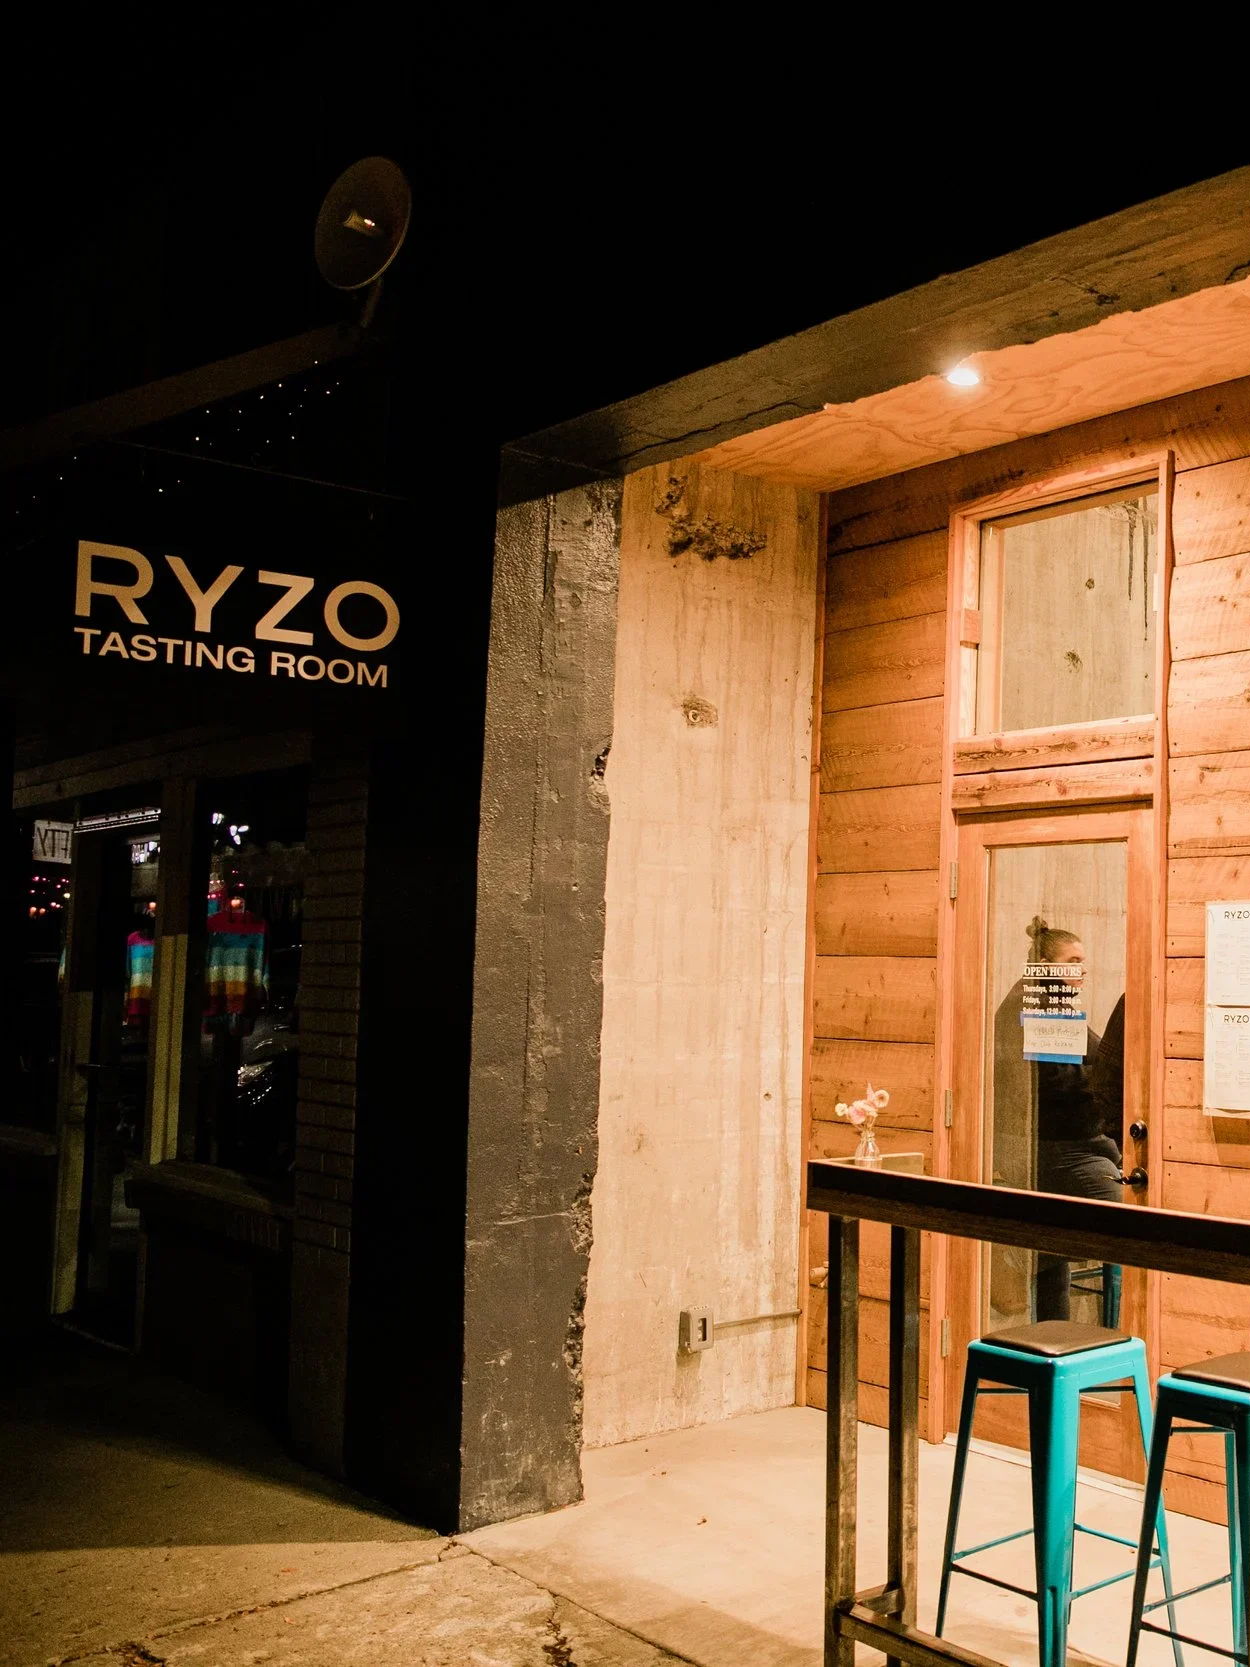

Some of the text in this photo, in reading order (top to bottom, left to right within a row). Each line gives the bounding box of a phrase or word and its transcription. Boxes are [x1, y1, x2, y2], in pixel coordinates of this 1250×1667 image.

[74, 540, 400, 651] RYZO
[74, 627, 388, 688] TASTING ROOM
[1224, 910, 1250, 920] RYZO
[1024, 966, 1082, 977] OPEN HOURS
[1022, 985, 1047, 994] Thursdays,
[1049, 985, 1058, 993] 3:00
[1022, 996, 1041, 1005] Fridays,
[1049, 996, 1058, 1004] 3:00
[1022, 1007, 1046, 1018] Saturdays,
[1223, 1014, 1250, 1024] RYZO
